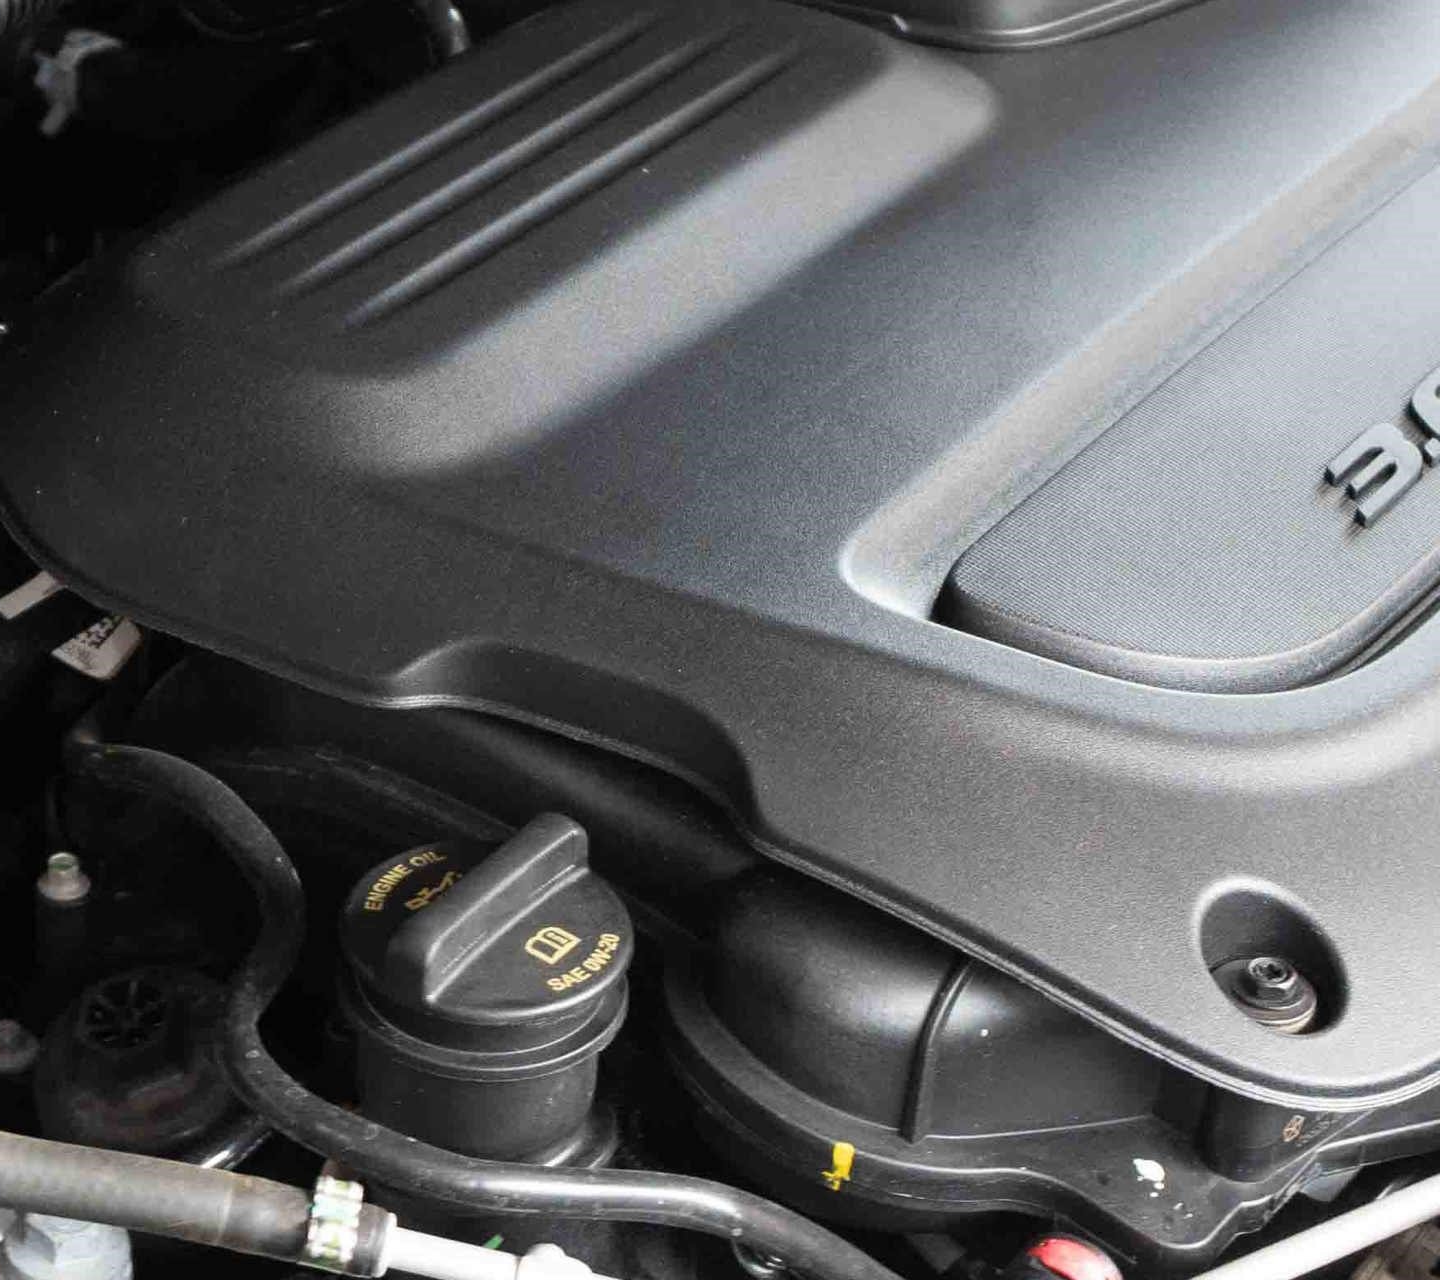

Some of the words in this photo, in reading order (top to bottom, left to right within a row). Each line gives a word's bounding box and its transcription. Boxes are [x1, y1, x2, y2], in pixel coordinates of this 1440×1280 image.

[364, 864, 413, 912] ENGINE
[410, 850, 447, 868] OIL
[546, 966, 591, 992] SAE
[581, 932, 621, 971] 0W-20
